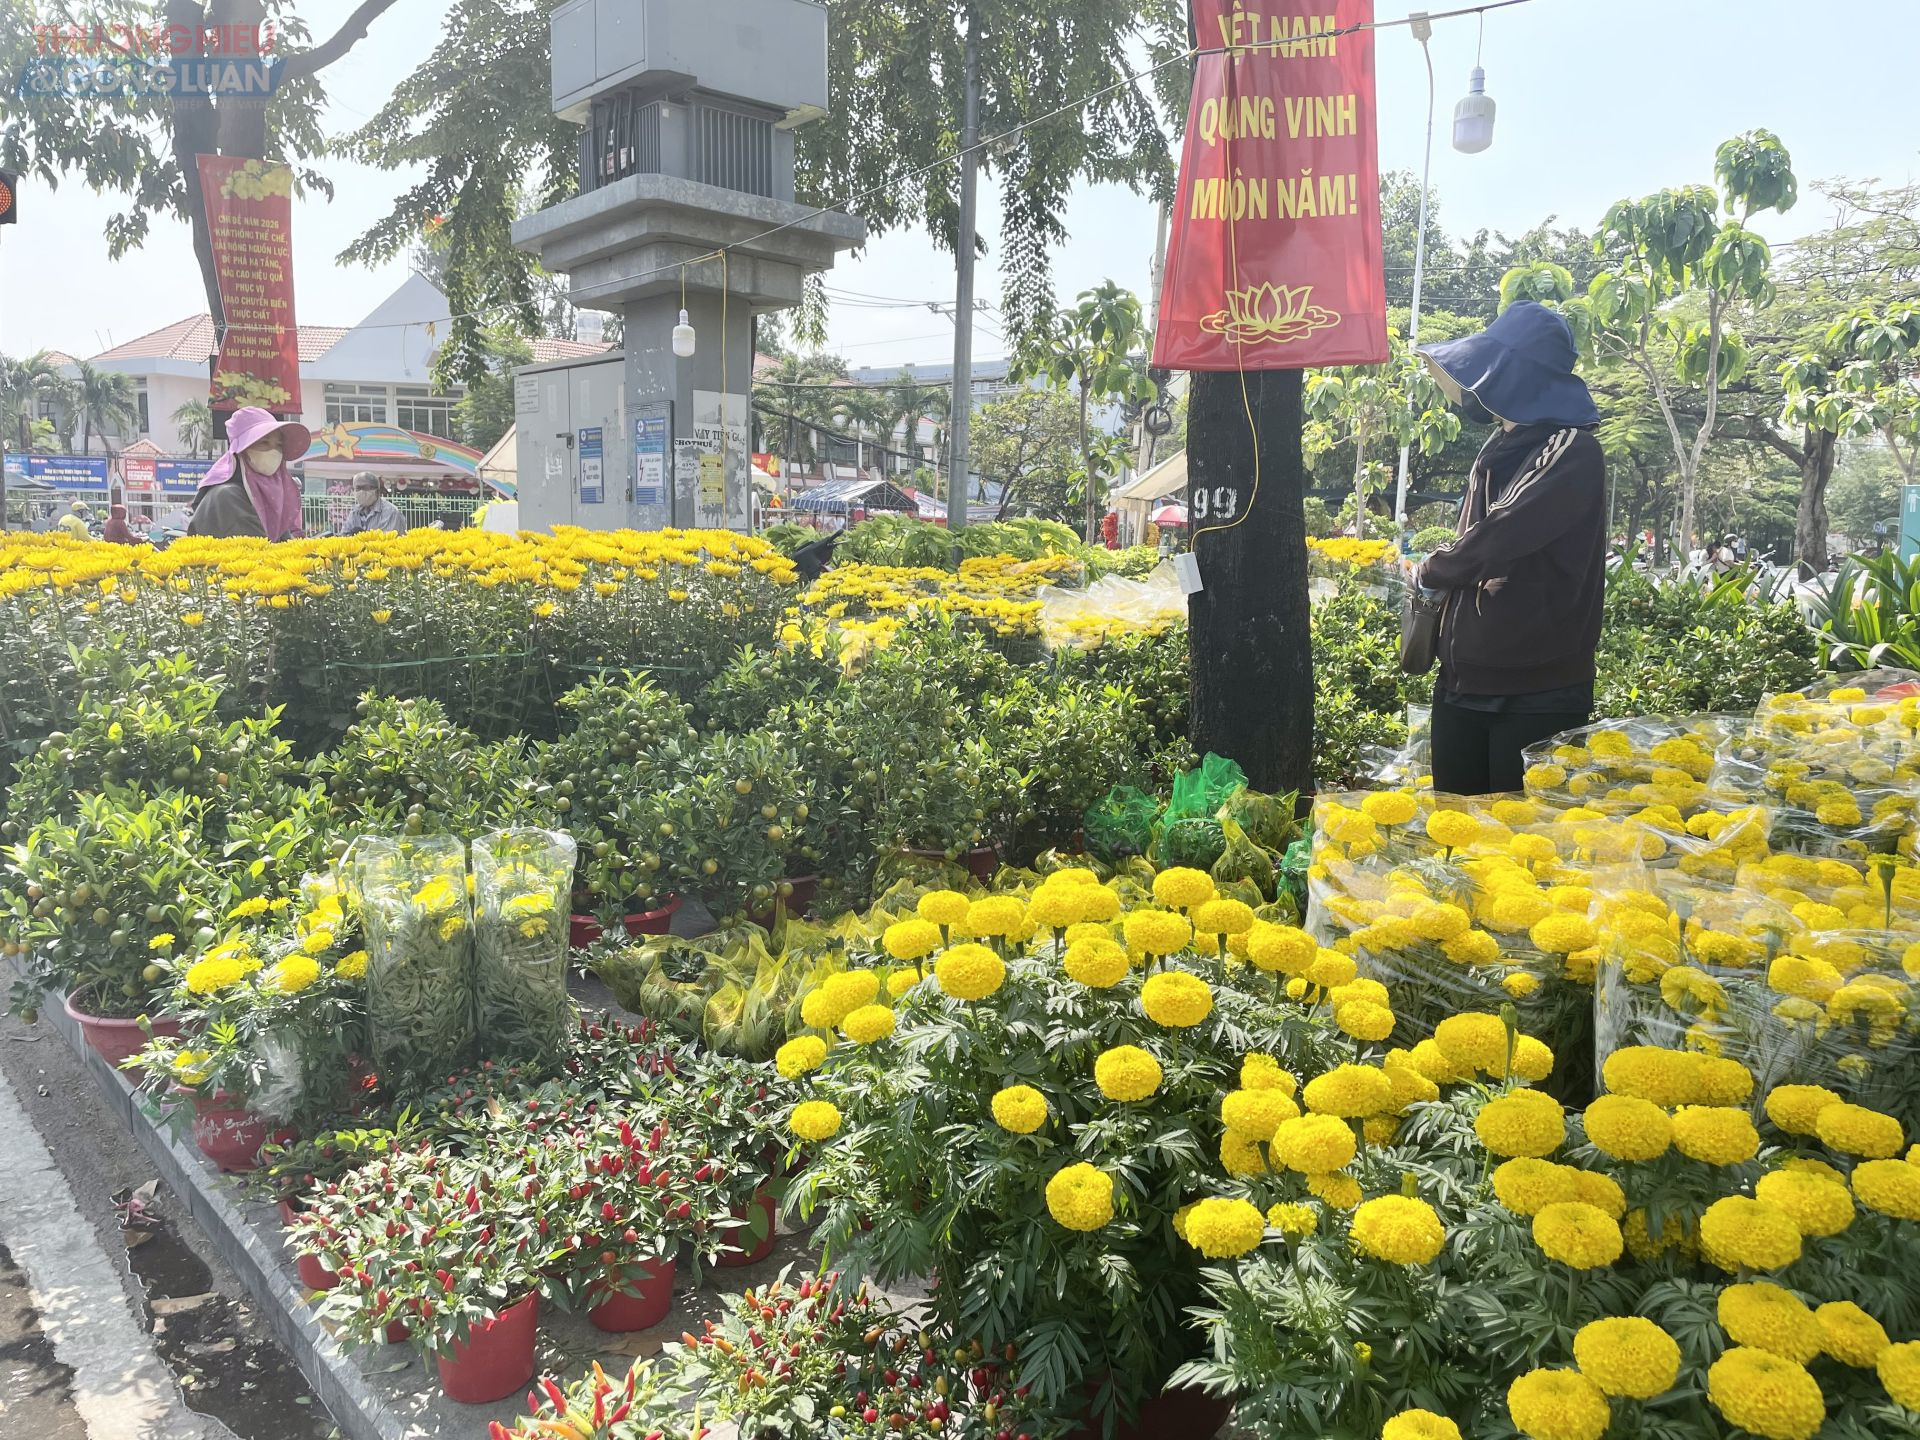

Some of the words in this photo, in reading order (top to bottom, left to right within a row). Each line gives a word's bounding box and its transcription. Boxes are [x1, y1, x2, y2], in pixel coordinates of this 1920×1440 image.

[1270, 15, 1337, 58] NAM
[1284, 94, 1357, 139] VINH
[1190, 167, 1268, 221] MUÔN
[1276, 167, 1359, 220] NĂM!
[260, 219, 279, 229] 2026
[236, 270, 250, 279] CAO
[1194, 486, 1237, 519] 99
